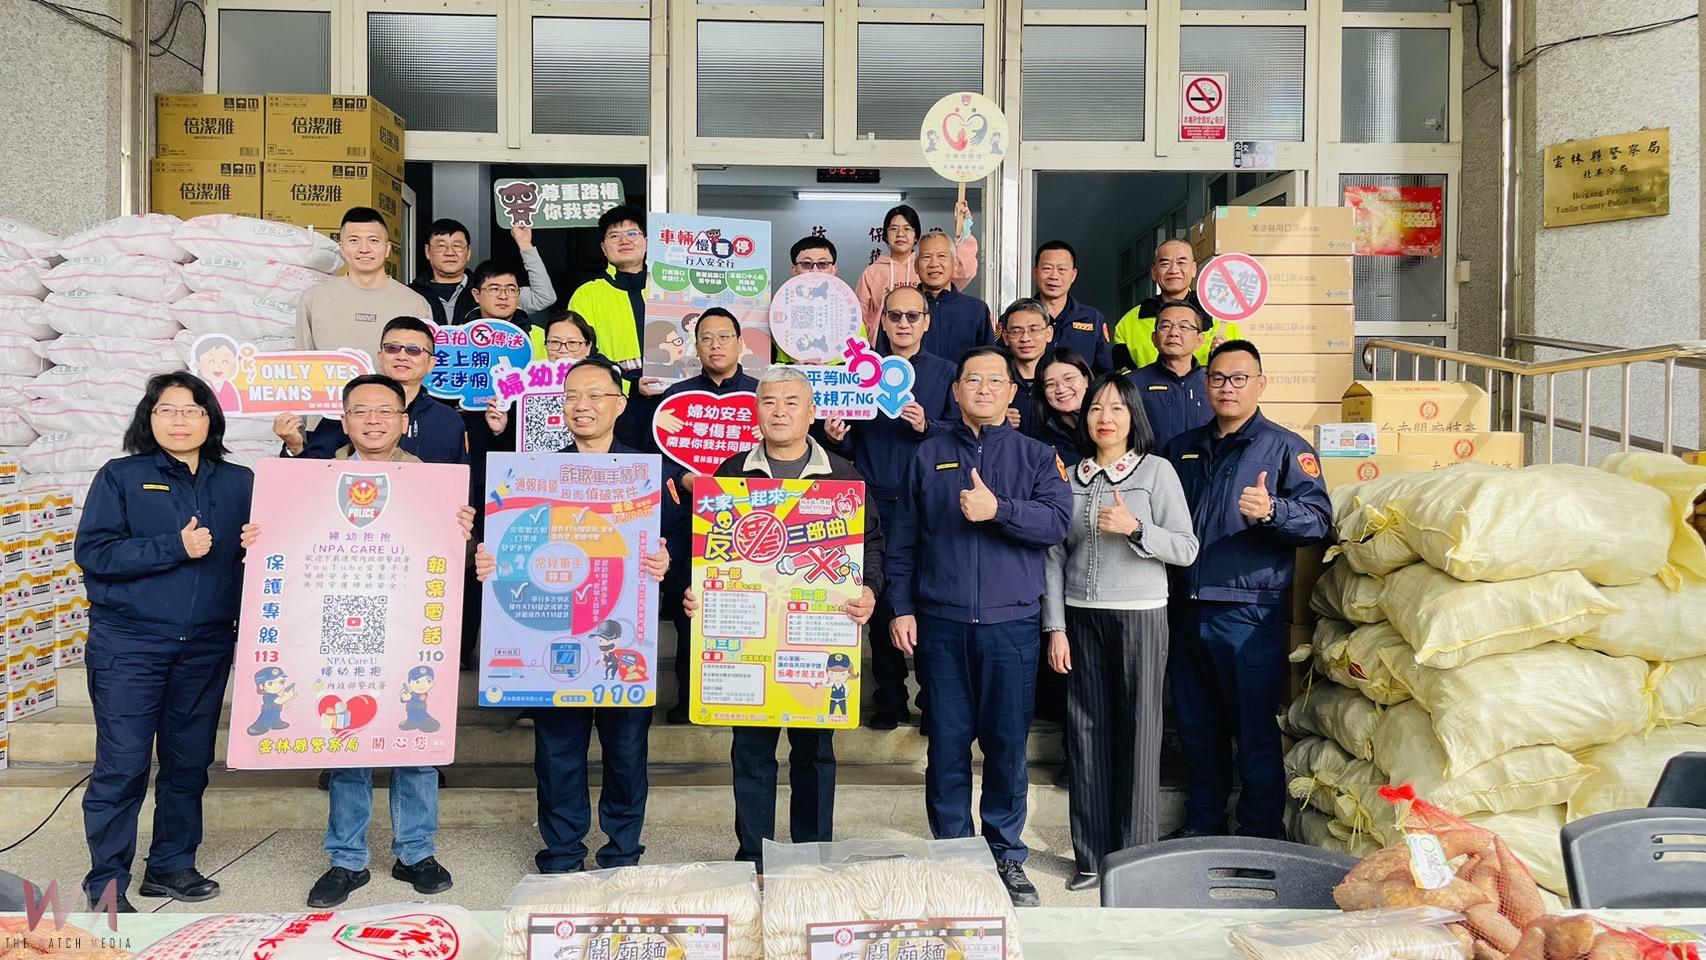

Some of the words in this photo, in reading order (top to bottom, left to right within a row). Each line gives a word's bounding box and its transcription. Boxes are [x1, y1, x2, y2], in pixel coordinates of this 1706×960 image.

[184, 116, 235, 135] 倍潔雅
[292, 116, 343, 135] 倍潔雅
[1553, 141, 1660, 168] 雲林縣警察局
[180, 182, 232, 200] 倍潔雅
[291, 184, 343, 202] 倍潔雅
[541, 183, 619, 200] 尊重路權
[1572, 190, 1603, 200] Beigang
[1606, 185, 1640, 195] Precinct
[1555, 205, 1579, 214] Yunlin
[1581, 202, 1605, 211] County
[1608, 199, 1629, 208] Police
[685, 256, 735, 269] 行人安全行
[434, 324, 525, 348] 自拍不傳送
[434, 351, 490, 368] 全上網
[261, 364, 310, 380] ONLY
[325, 365, 360, 380] YES
[807, 370, 861, 386] 平等ING
[249, 386, 312, 401] MEANS
[325, 386, 343, 401] YE
[687, 404, 753, 422] 婦幼安全
[349, 508, 375, 519] POLICE
[329, 532, 391, 542] 婦幼抱抱
[312, 544, 345, 554] (NPA
[350, 545, 385, 554] CARE
[391, 546, 405, 555] U)
[706, 567, 742, 580] 第一部
[258, 554, 285, 644] 保護專線
[421, 556, 447, 645] 報案電話
[254, 651, 279, 662] 113
[327, 657, 347, 665] NPA
[348, 657, 368, 665] Care
[368, 657, 377, 665] U
[418, 650, 444, 662] 110
[321, 667, 381, 677] 婦幼抱抱
[593, 685, 645, 704] 110
[258, 737, 360, 754] 雲林縣警察局
[371, 737, 428, 751] 關心您
[588, 937, 668, 960] 關廟麵
[867, 940, 947, 960] 關廟麵
